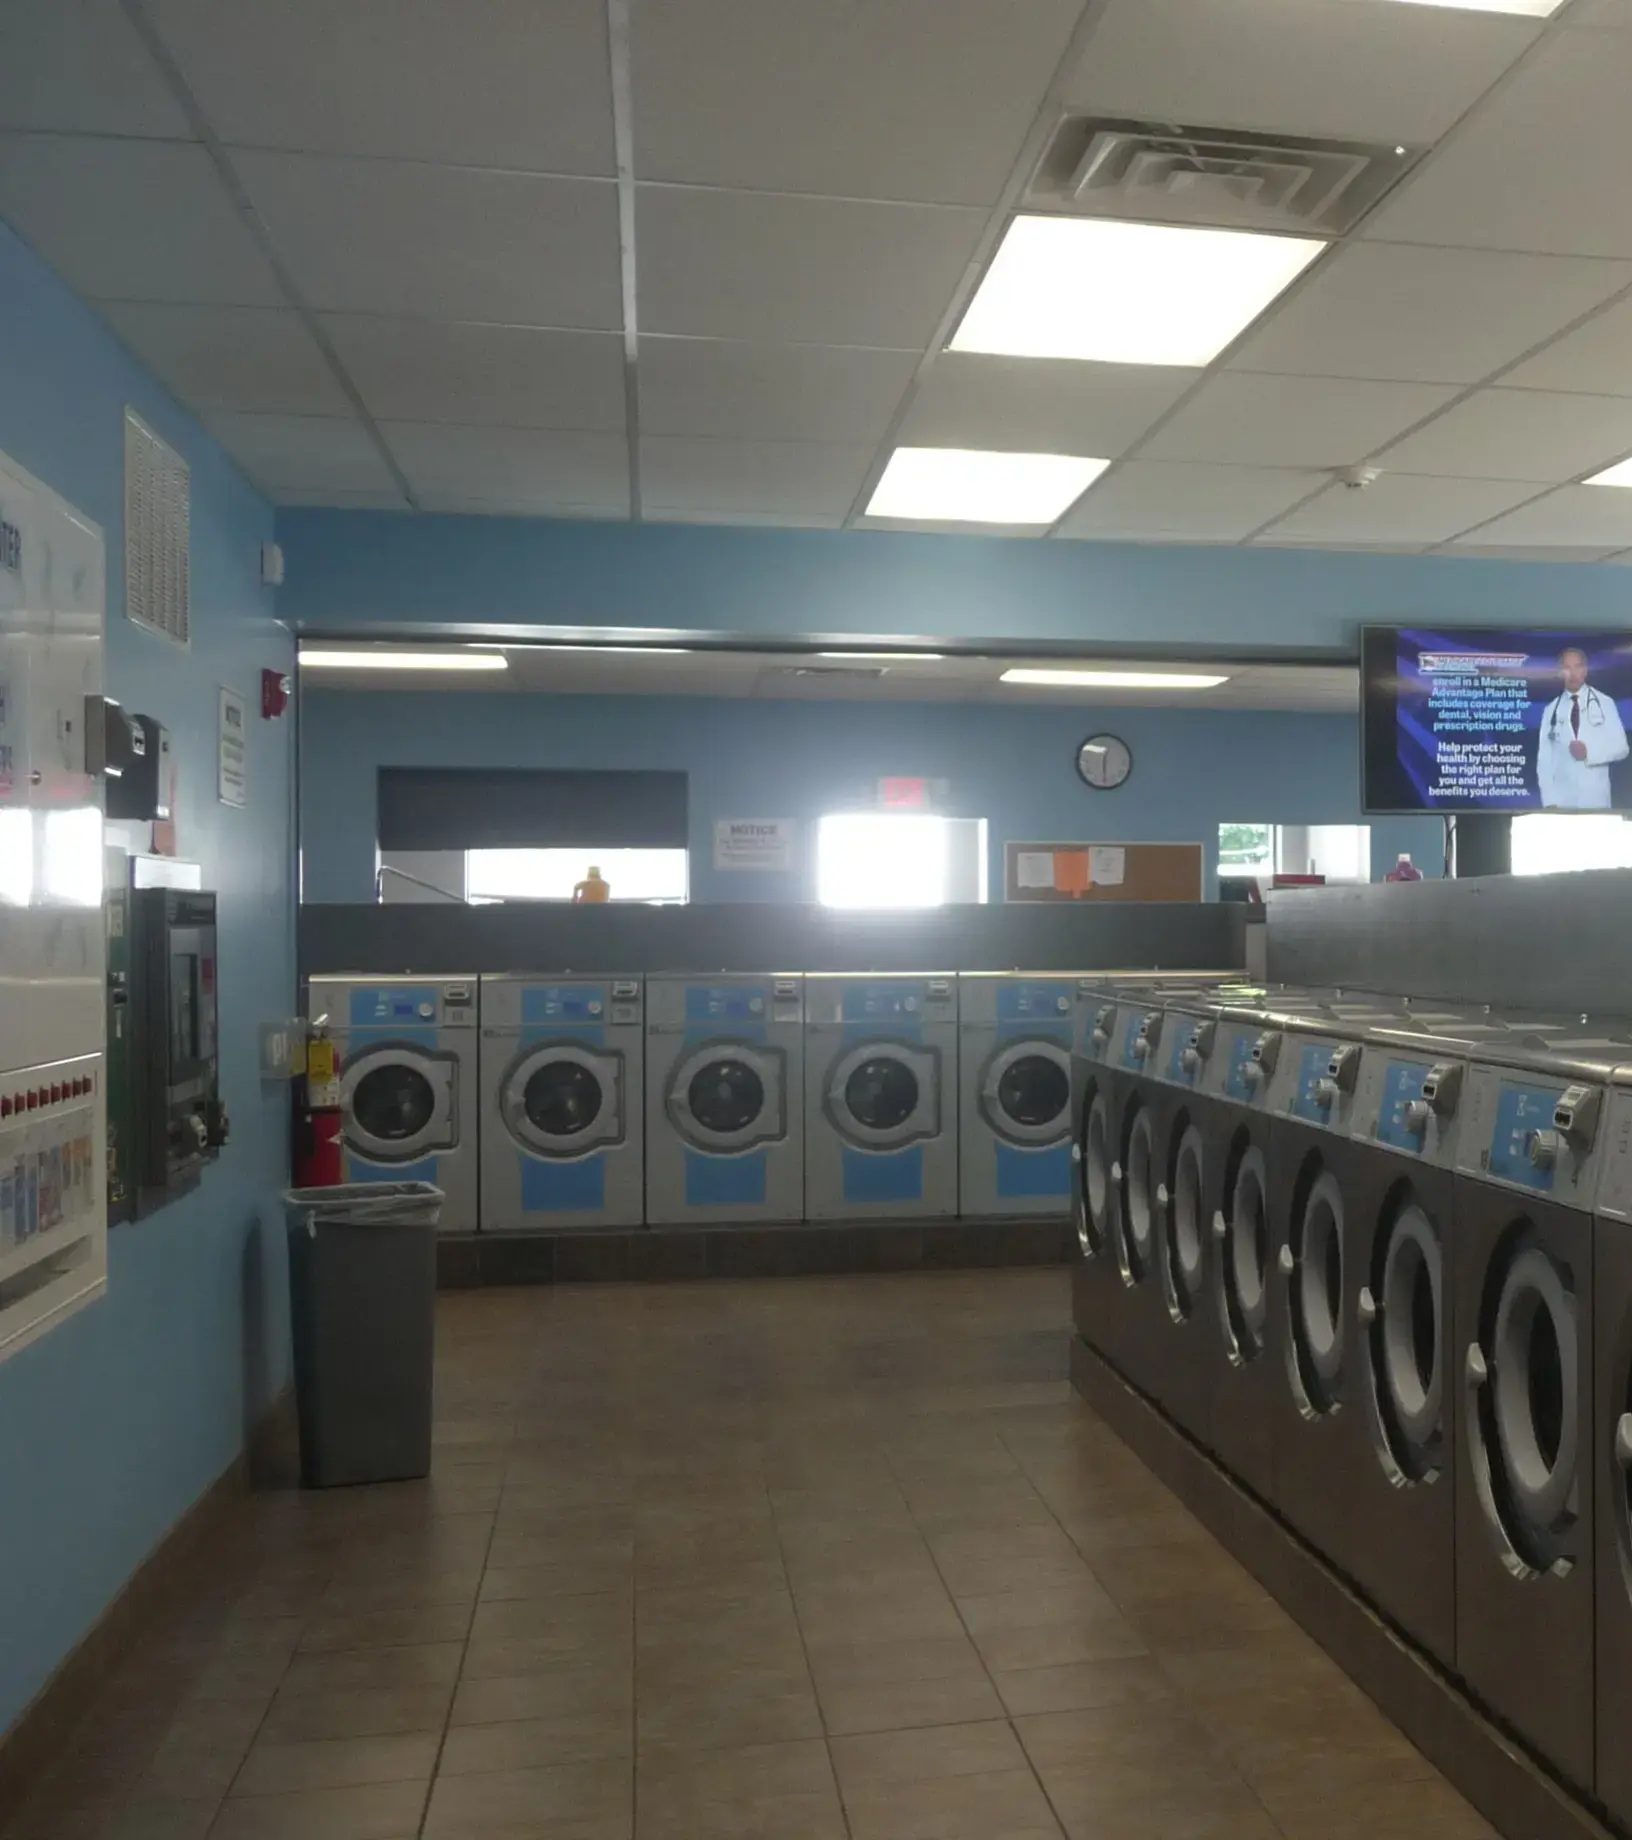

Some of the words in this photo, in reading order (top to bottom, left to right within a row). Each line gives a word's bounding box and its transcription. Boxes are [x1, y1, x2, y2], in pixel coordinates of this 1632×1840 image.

[1433, 677, 1461, 687] enroll
[1463, 678, 1472, 687] in
[1481, 677, 1528, 687] Medicare
[1432, 688, 1484, 699] Advantage
[1485, 688, 1507, 698] Plan
[1508, 688, 1528, 698] that
[1428, 698, 1469, 709] includes
[1470, 701, 1514, 710] coverage
[1516, 699, 1532, 709] for
[1439, 710, 1471, 720] dental,
[1473, 710, 1501, 719] vision
[1503, 711, 1521, 720] and
[1433, 721, 1494, 732] prescription
[1495, 721, 1526, 732] drugs.
[1438, 741, 1461, 753] Help
[1462, 743, 1498, 754] protect
[1499, 744, 1523, 754] your
[1437, 753, 1467, 763] health
[1469, 754, 1480, 764] by
[1482, 754, 1526, 765] choosing
[1441, 764, 1458, 774] the
[1459, 765, 1483, 776] right
[1484, 765, 1505, 775] plan
[1506, 765, 1522, 774] for
[1439, 777, 1457, 787] you
[1458, 776, 1476, 785] and
[1478, 777, 1493, 787] get
[1495, 776, 1507, 785] all
[1508, 776, 1524, 785] the
[1428, 786, 1469, 796] benefits
[1470, 788, 1488, 798] you
[1489, 787, 1531, 797] deserve.
[730, 824, 777, 836] NOTICE
